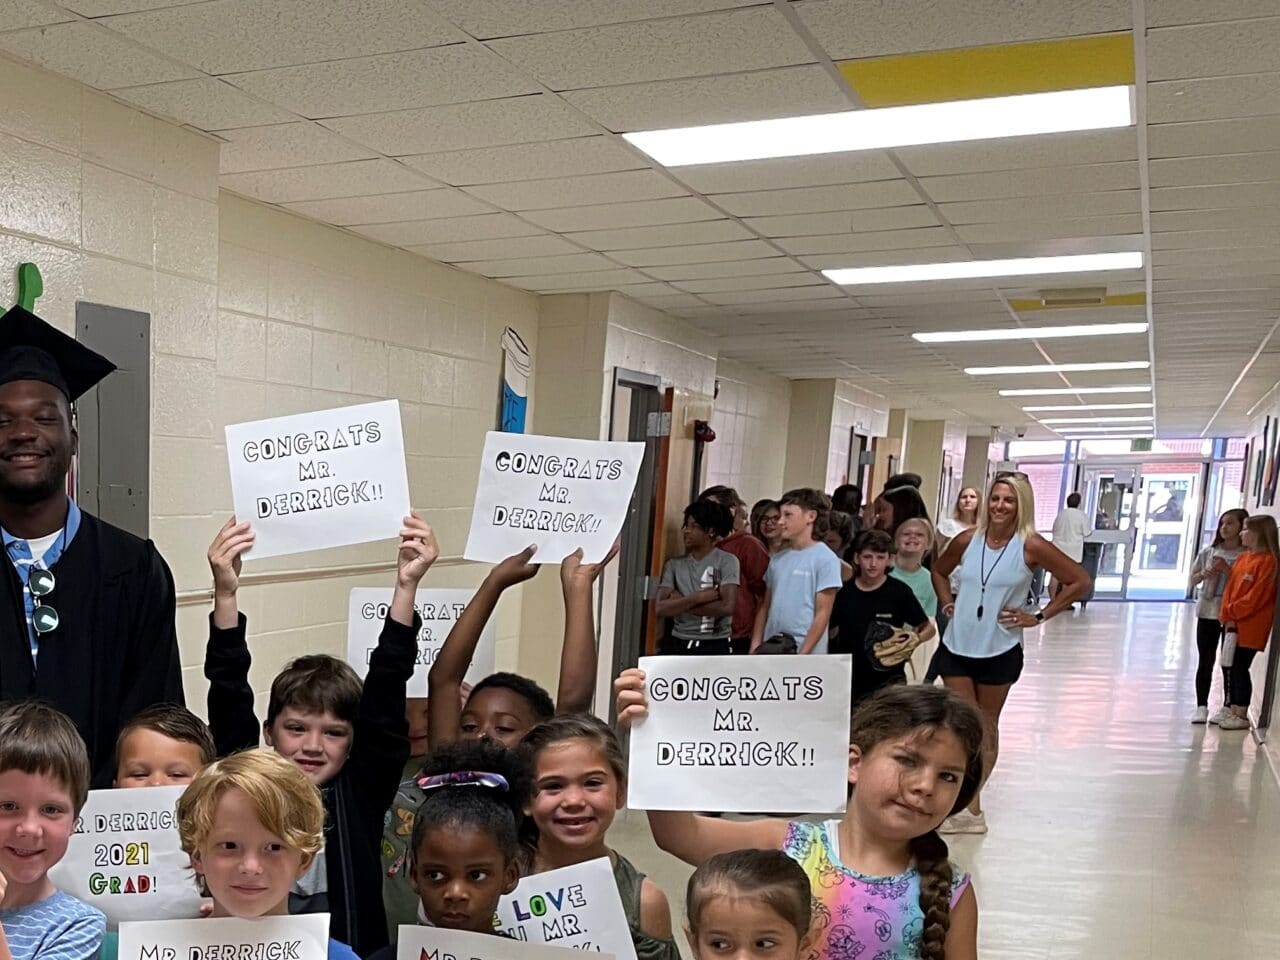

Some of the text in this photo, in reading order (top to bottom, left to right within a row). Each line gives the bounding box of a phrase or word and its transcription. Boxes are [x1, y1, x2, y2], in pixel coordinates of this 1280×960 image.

[243, 421, 382, 463] CONGRATS
[298, 460, 336, 482] MR.
[495, 451, 623, 480] CONGRATS
[257, 480, 384, 519] DERRICK!!
[539, 482, 571, 504] MR.
[492, 505, 602, 533] DERRICK!!
[362, 602, 465, 620] CORAT
[650, 675, 823, 701] CONGRATS
[713, 708, 759, 731] MR.
[657, 741, 815, 766] DERRICK!!
[74, 811, 178, 833] R. DERRIC
[95, 842, 149, 867] 2021
[89, 872, 157, 895] GRAD!
[512, 884, 587, 921] LOVE
[542, 914, 588, 942] MR.
